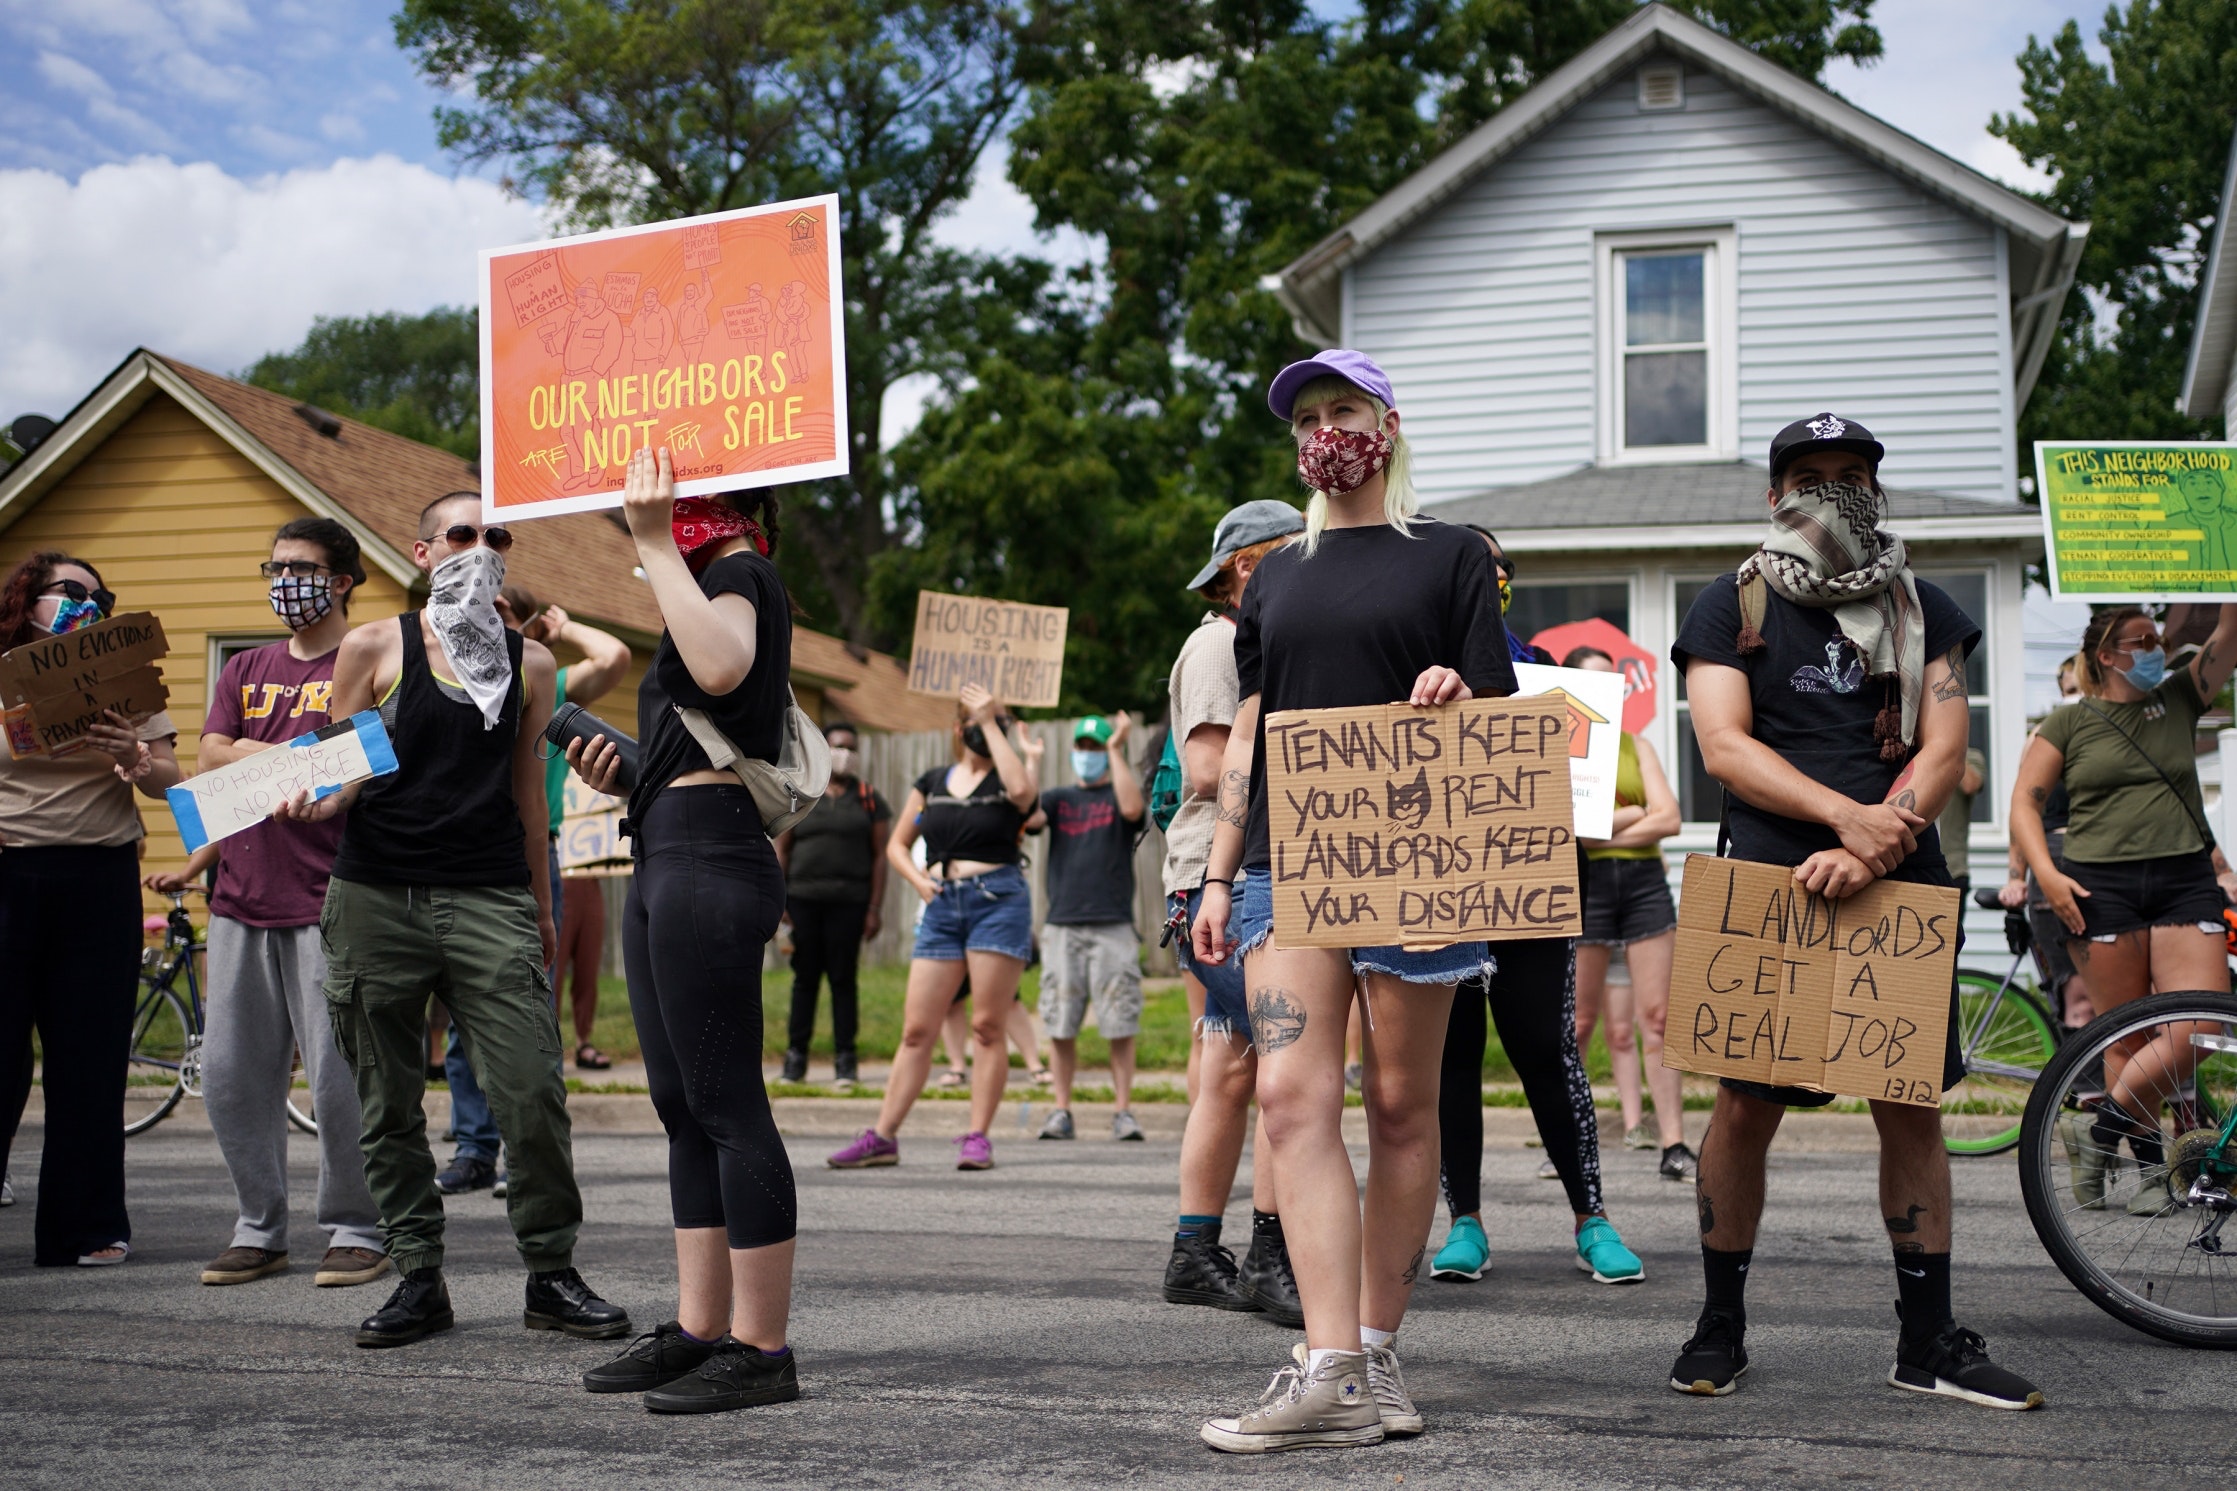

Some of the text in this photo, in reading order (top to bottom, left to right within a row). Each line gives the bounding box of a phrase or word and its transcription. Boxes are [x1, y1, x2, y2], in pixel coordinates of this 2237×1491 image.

[509, 261, 552, 288] HOUSING
[516, 284, 558, 314] HUMAN
[520, 294, 565, 323] RIGHT
[529, 351, 788, 431] OUR NEIGHBORS
[519, 396, 805, 480] ARE NOT FOR SALE
[2055, 449, 2232, 476] THIS NEIGHBORHOOD
[2091, 472, 2172, 489] STANDS FOR
[2062, 494, 2141, 503] RACIAL JUSTICE
[2066, 511, 2140, 520] RENT CONTROL
[2062, 530, 2173, 539] COMMUNITY OWNERSHIP
[2061, 551, 2174, 560] TENANT COOPERATIVES
[2064, 571, 2110, 580] STOPPING
[2111, 571, 2157, 580] EVICTIONS
[2168, 572, 2232, 580] DISPLACEMENT
[923, 598, 1060, 642] HOUSING
[29, 625, 154, 675] NO EVICTIONS
[973, 638, 1010, 653] IS A
[73, 669, 98, 691] IN
[912, 646, 1061, 702] HUMAN RIGHT
[84, 693, 98, 707] A
[242, 683, 284, 719] U
[1267, 712, 1562, 775] TENANTS KEEP
[196, 744, 325, 803] NO HOUSING
[233, 747, 355, 821] NO PEACE
[1286, 765, 1551, 837] YOUR RENT
[1277, 824, 1570, 883] LANDLORDS KEEP
[1301, 881, 1578, 933] YOUR DISTANCE
[1720, 866, 1948, 960] LANDLORDS
[1707, 944, 1879, 1001] GET A
[1693, 1002, 1917, 1070] REAL JOB
[1883, 1077, 1938, 1105] 1312
